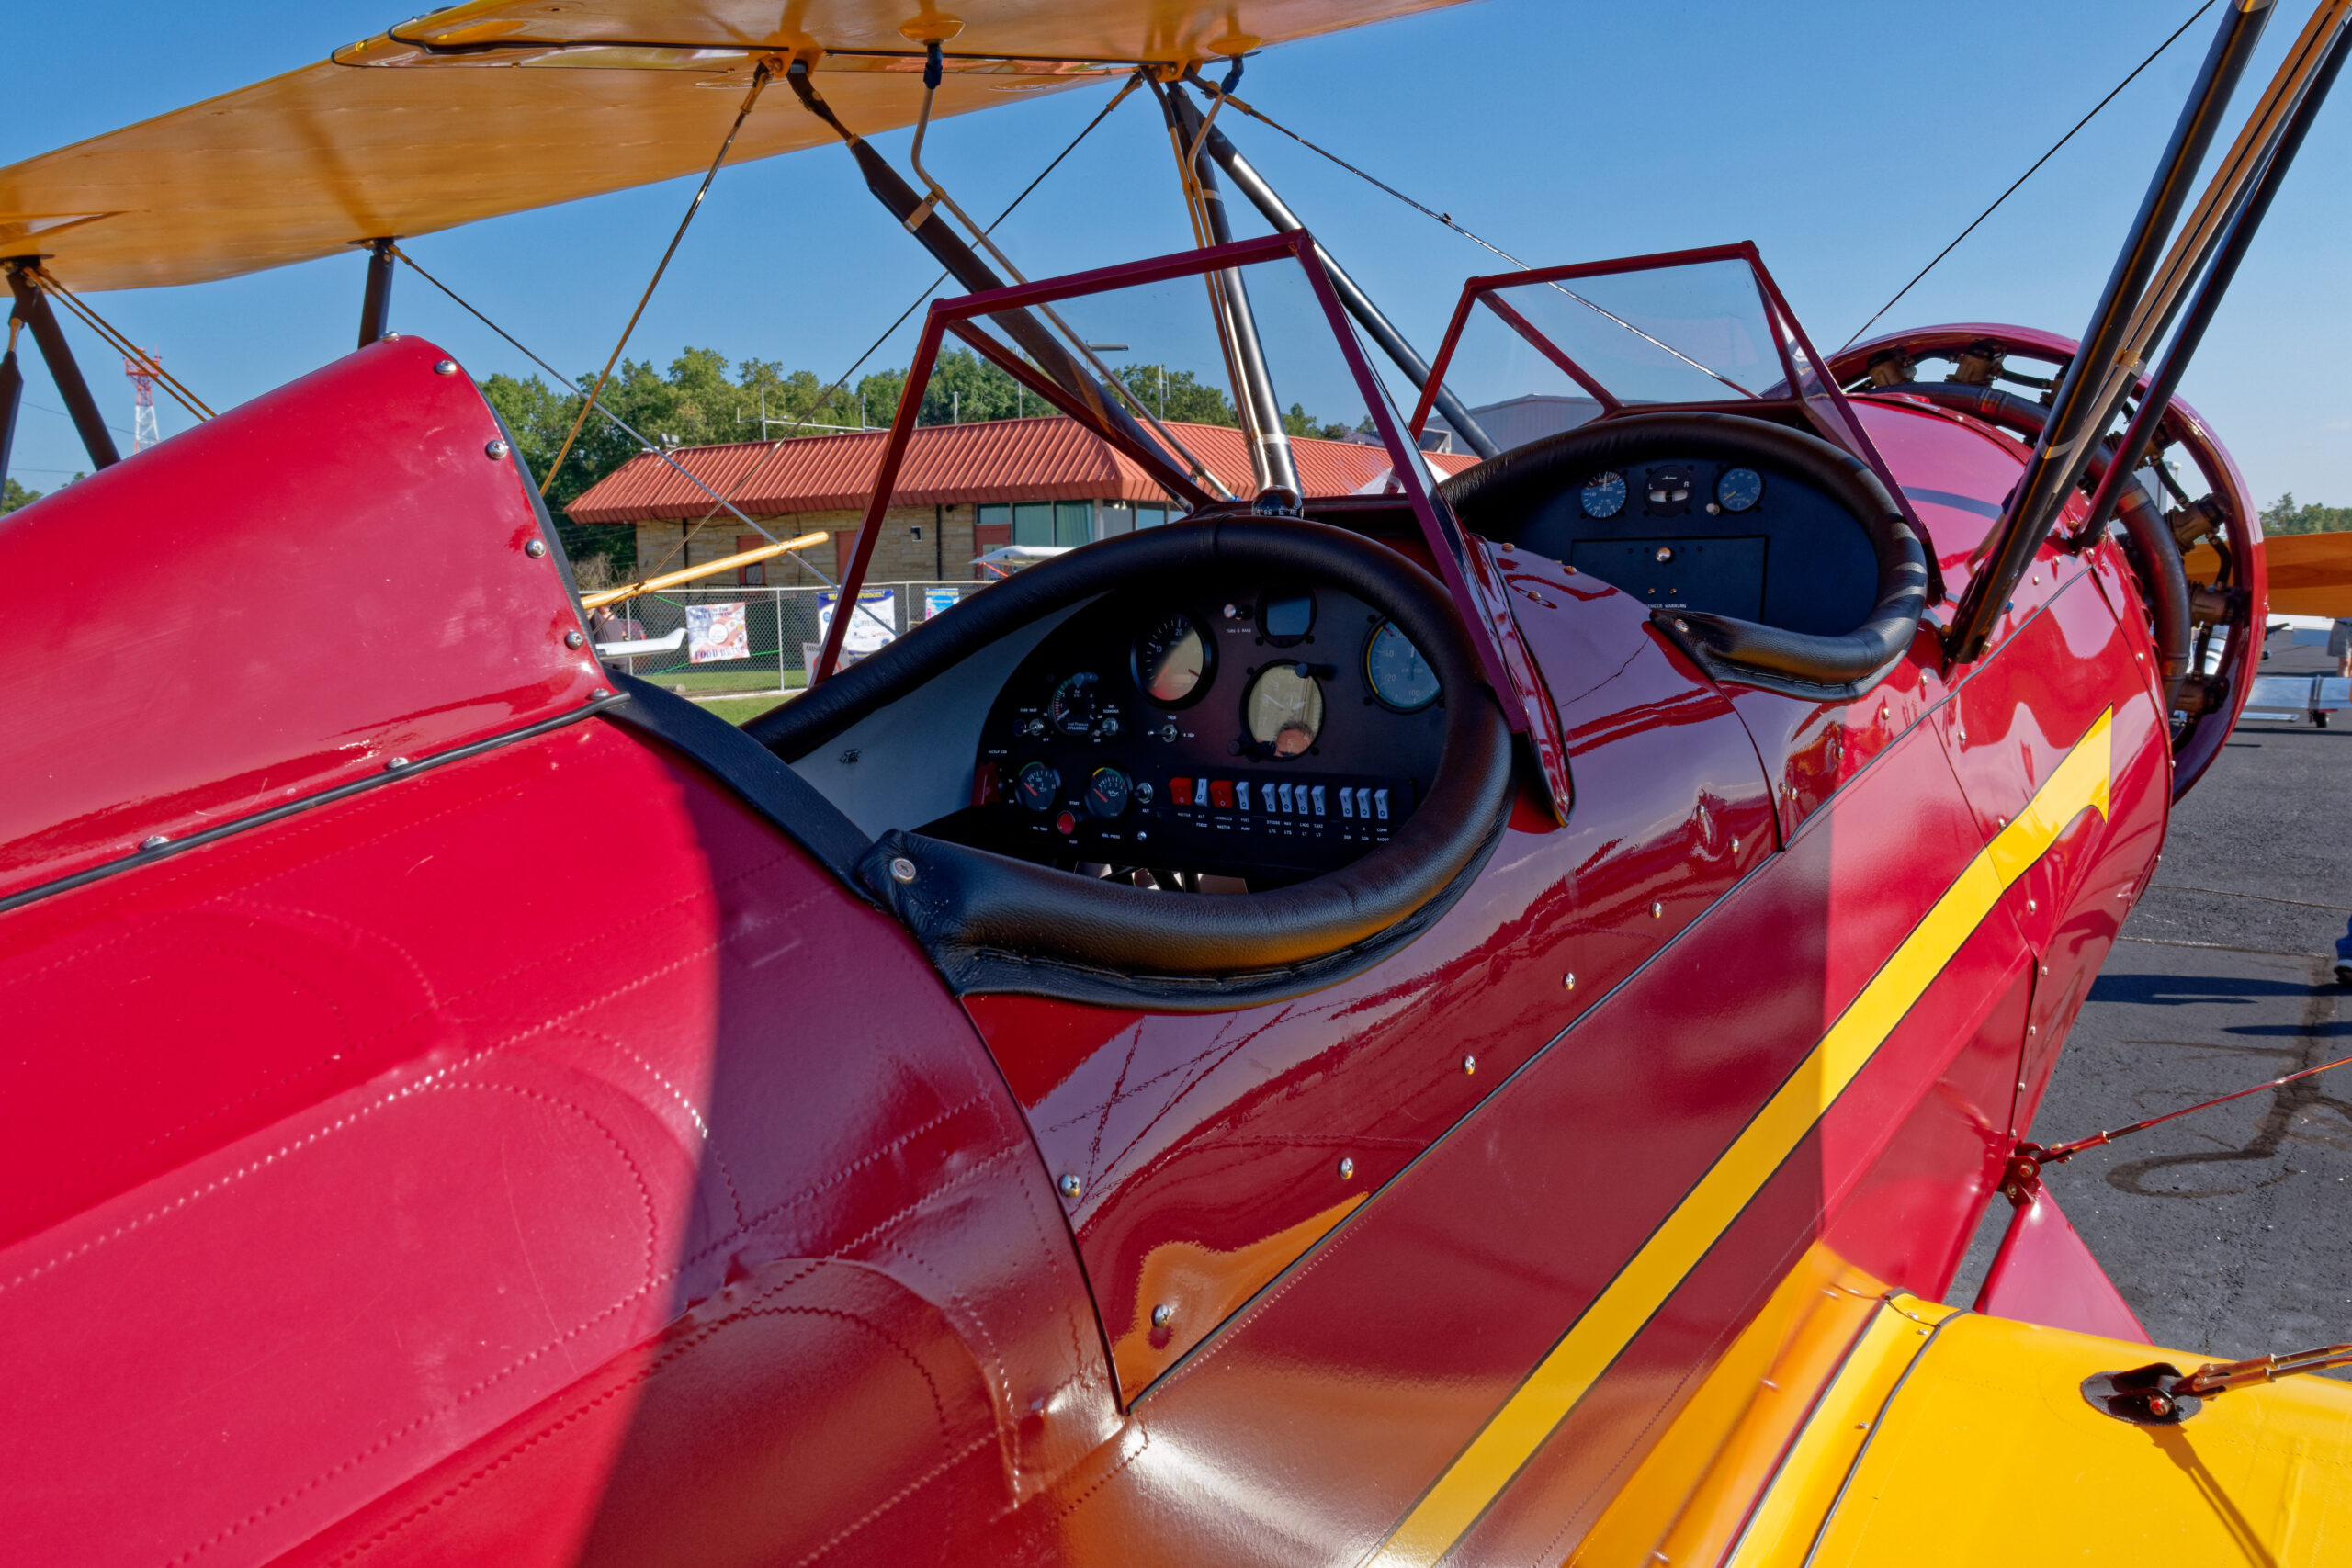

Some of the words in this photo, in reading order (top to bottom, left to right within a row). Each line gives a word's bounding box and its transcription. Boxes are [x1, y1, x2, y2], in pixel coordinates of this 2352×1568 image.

[1278, 508, 1284, 516] E
[1157, 645, 1163, 653] 10
[695, 649, 718, 660] FOOD
